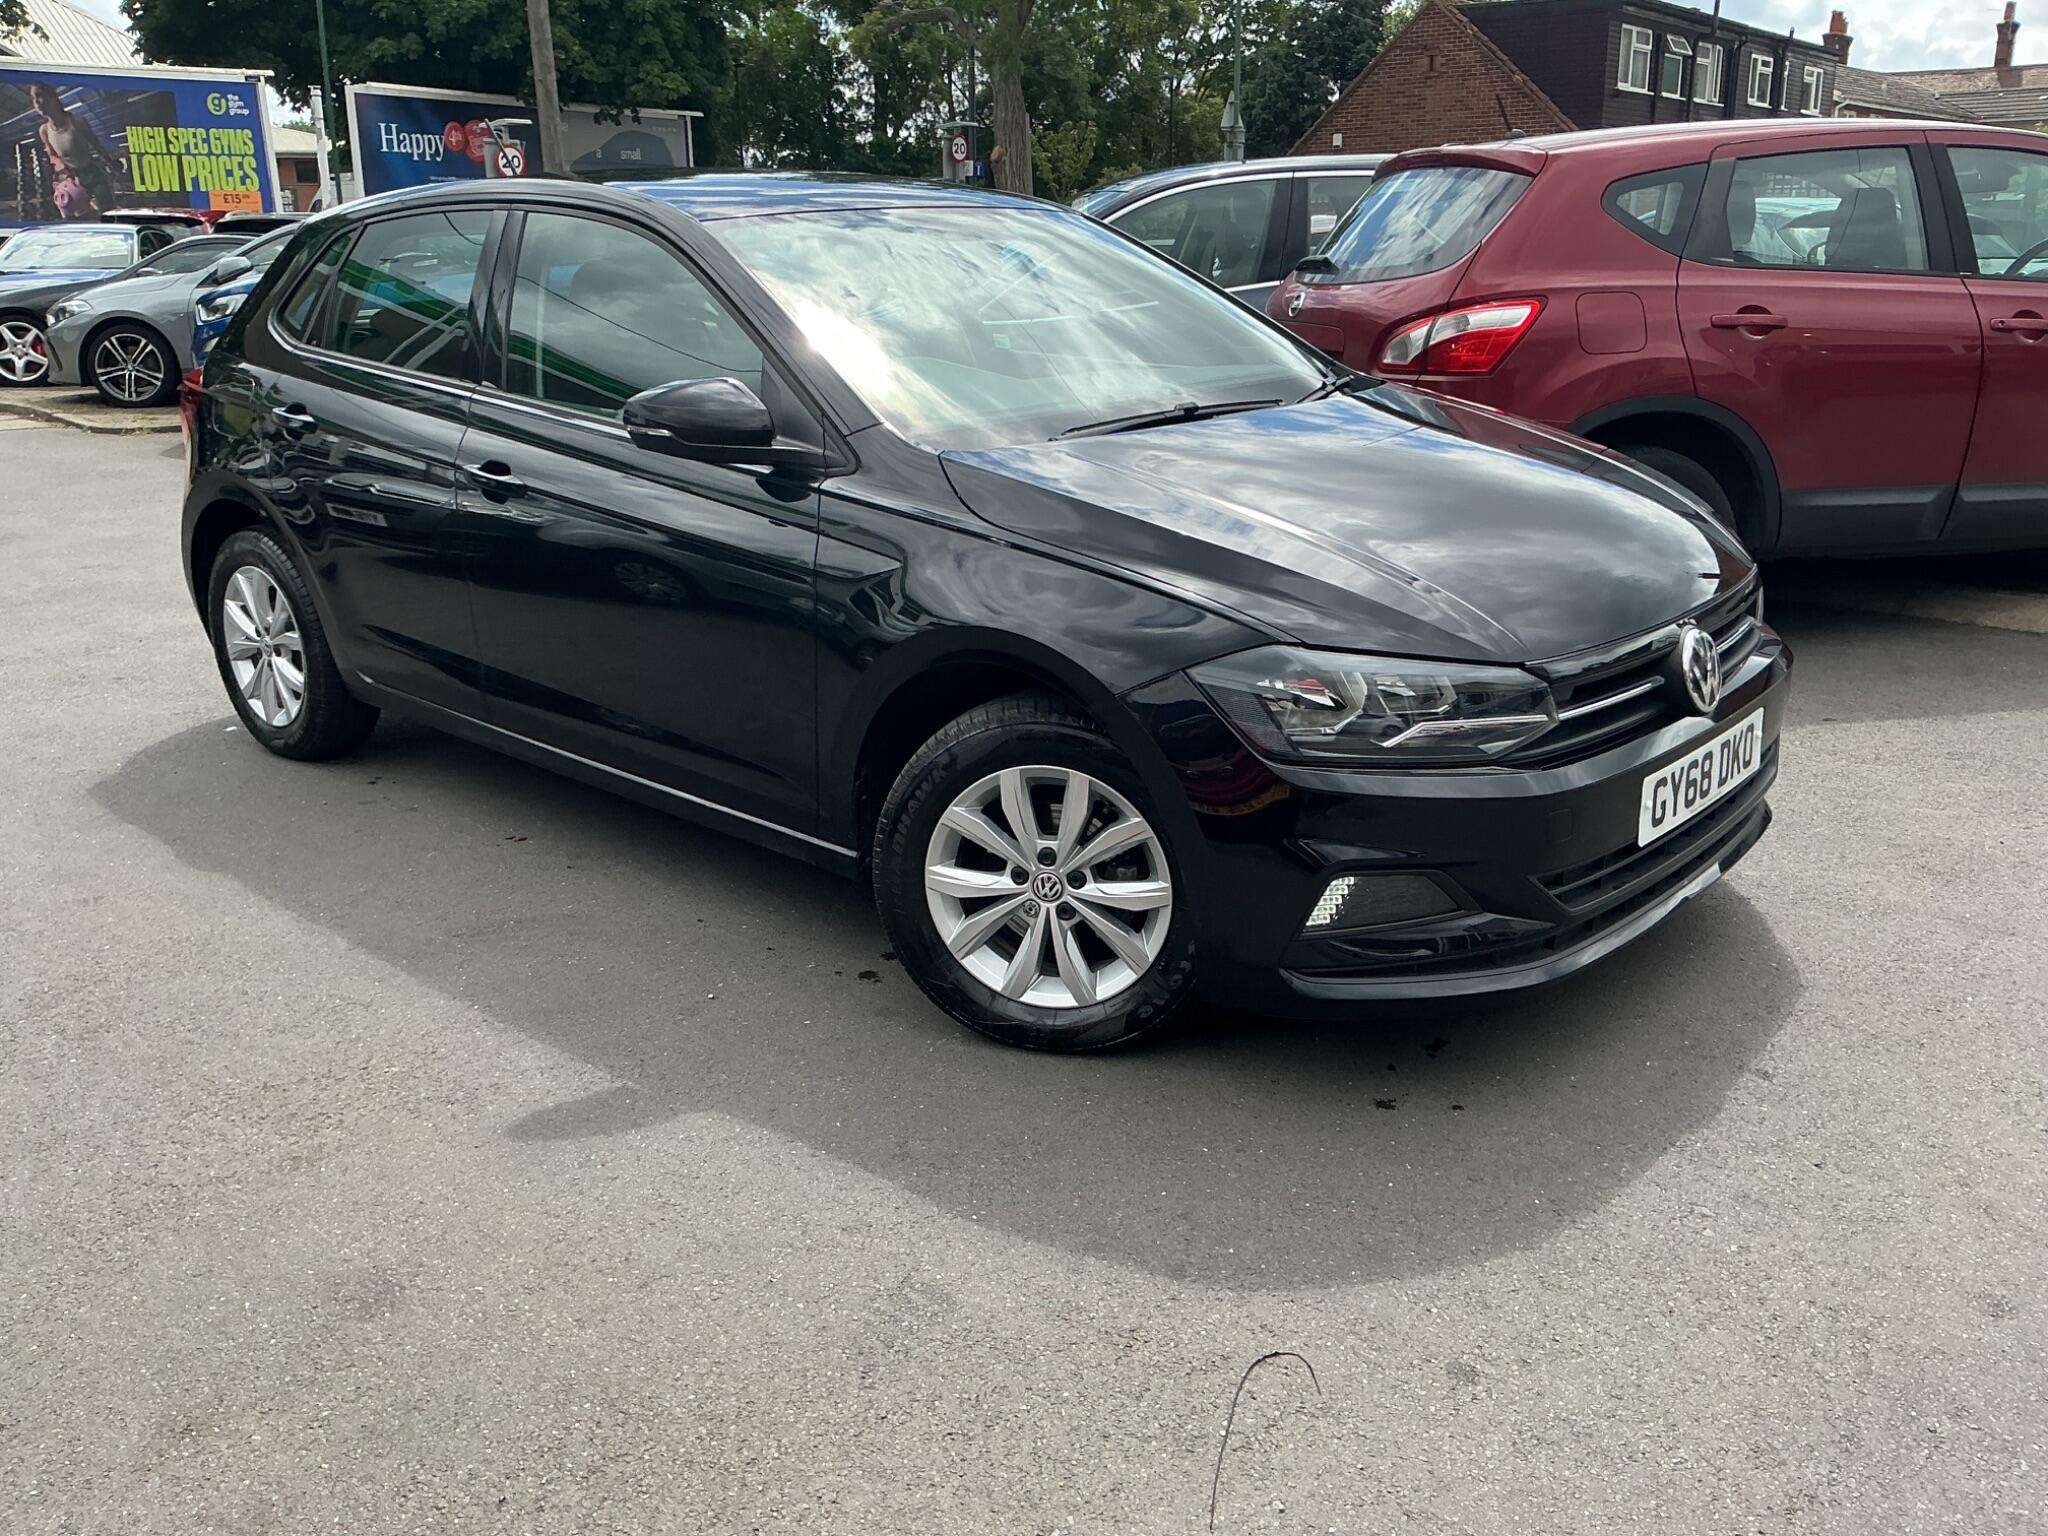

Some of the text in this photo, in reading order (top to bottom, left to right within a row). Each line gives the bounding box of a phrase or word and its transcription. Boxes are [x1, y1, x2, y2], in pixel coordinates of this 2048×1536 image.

[229, 108, 250, 116] group
[126, 126, 255, 155] HIGH SPEC GYMS
[377, 122, 445, 162] Happy
[954, 143, 966, 154] 20
[130, 154, 260, 192] LOW PRICES
[501, 155, 520, 169] 20
[1651, 723, 1755, 828] GY68 DKO
